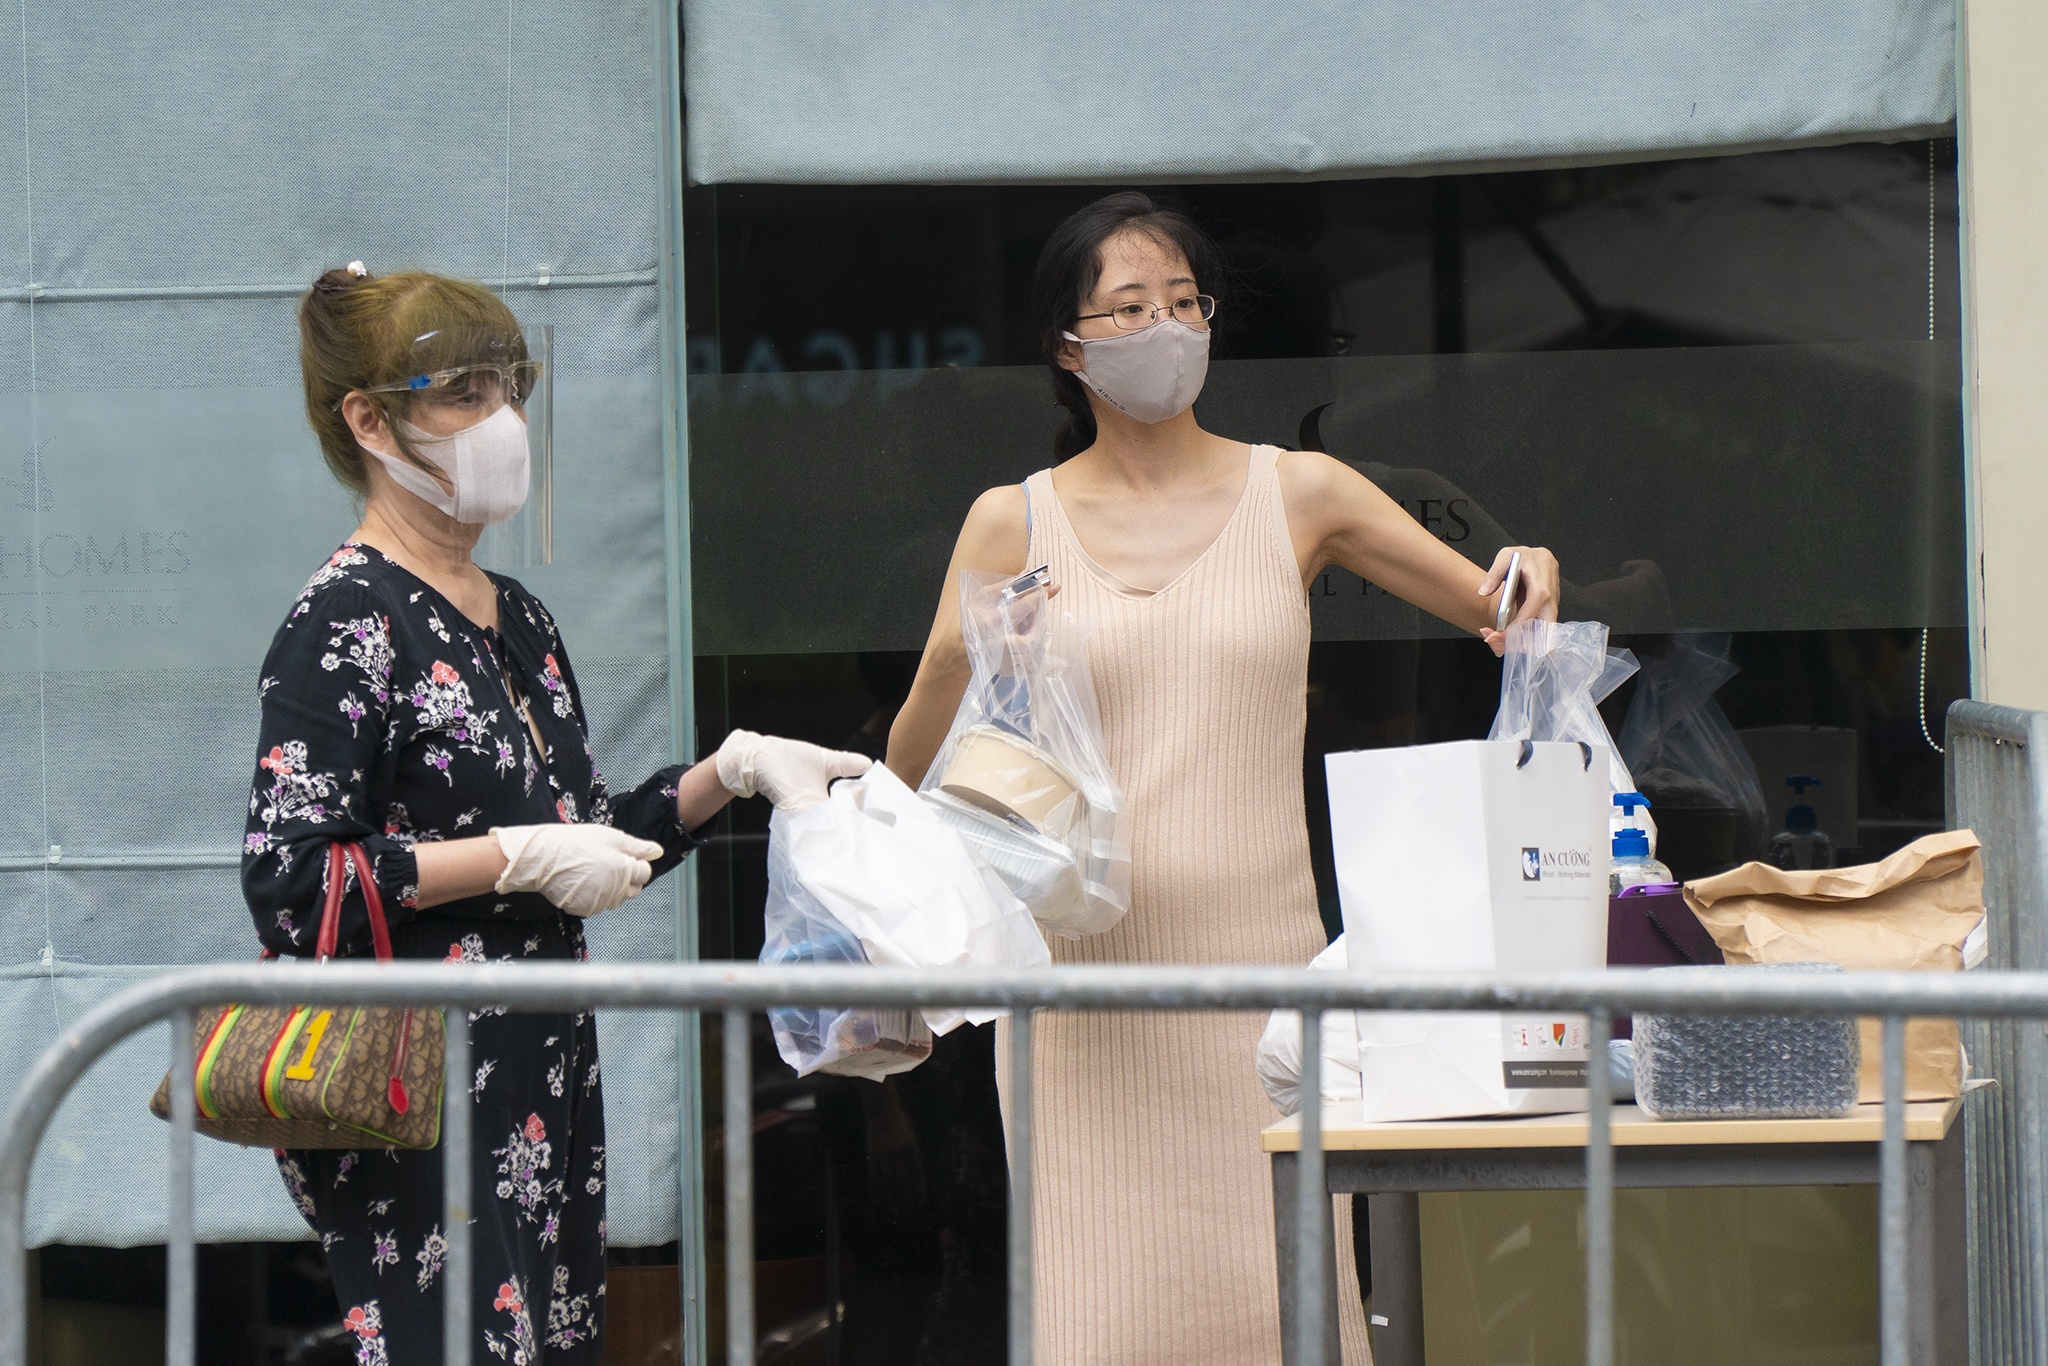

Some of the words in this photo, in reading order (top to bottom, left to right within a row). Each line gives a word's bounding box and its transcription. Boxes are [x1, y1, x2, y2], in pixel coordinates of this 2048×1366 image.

[84, 603, 178, 627] PARK
[1542, 852, 1555, 867] AN
[286, 1010, 332, 1081] 1
